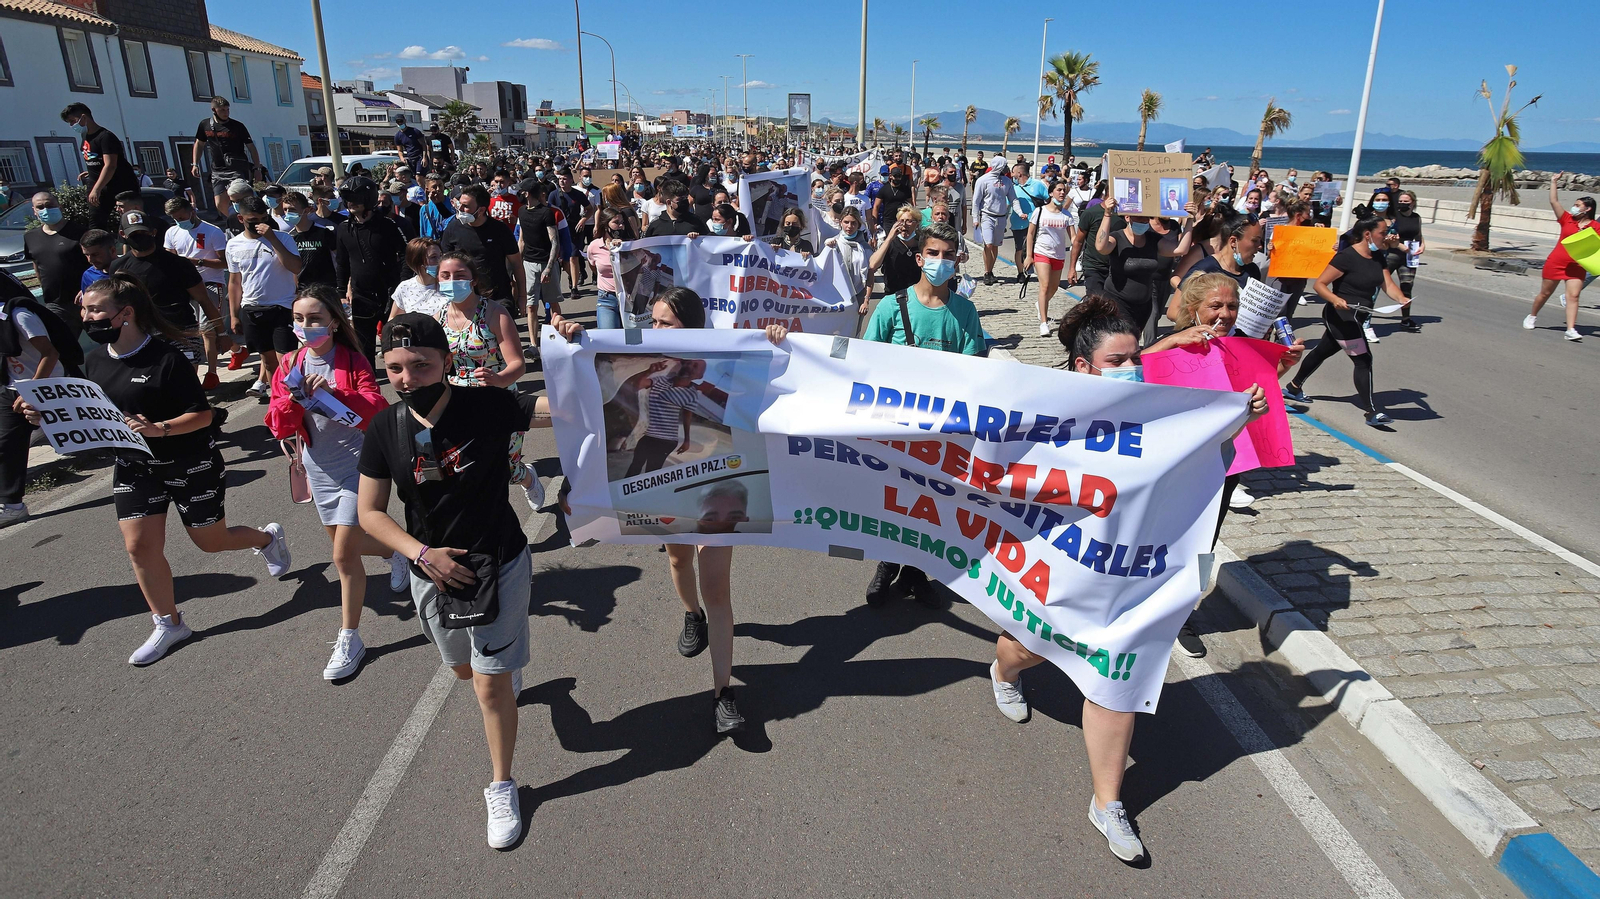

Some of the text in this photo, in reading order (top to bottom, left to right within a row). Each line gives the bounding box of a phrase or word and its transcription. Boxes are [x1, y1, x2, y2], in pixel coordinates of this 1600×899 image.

[1113, 154, 1171, 166] JUSTICIA
[491, 209, 503, 219] DO
[493, 201, 513, 210] JUST
[722, 254, 798, 279] PRIVARLES
[729, 275, 813, 299] LIBERTAD
[1251, 280, 1262, 289] Una
[1262, 286, 1279, 298] lancha
[701, 298, 845, 315] PERO NO QUITARLES
[1241, 296, 1256, 308] civiles
[1247, 307, 1257, 315] una
[32, 384, 101, 404] ¡BASTA
[40, 408, 73, 425] DE
[845, 381, 1143, 459] PRIVARLES DE
[622, 469, 683, 496] DESCANSAR
[685, 464, 699, 478] EN
[787, 436, 1168, 578] PERO NO QUITARLES
[884, 486, 1051, 606] LA VIDA
[985, 571, 1138, 681] JUSTICIA!!
